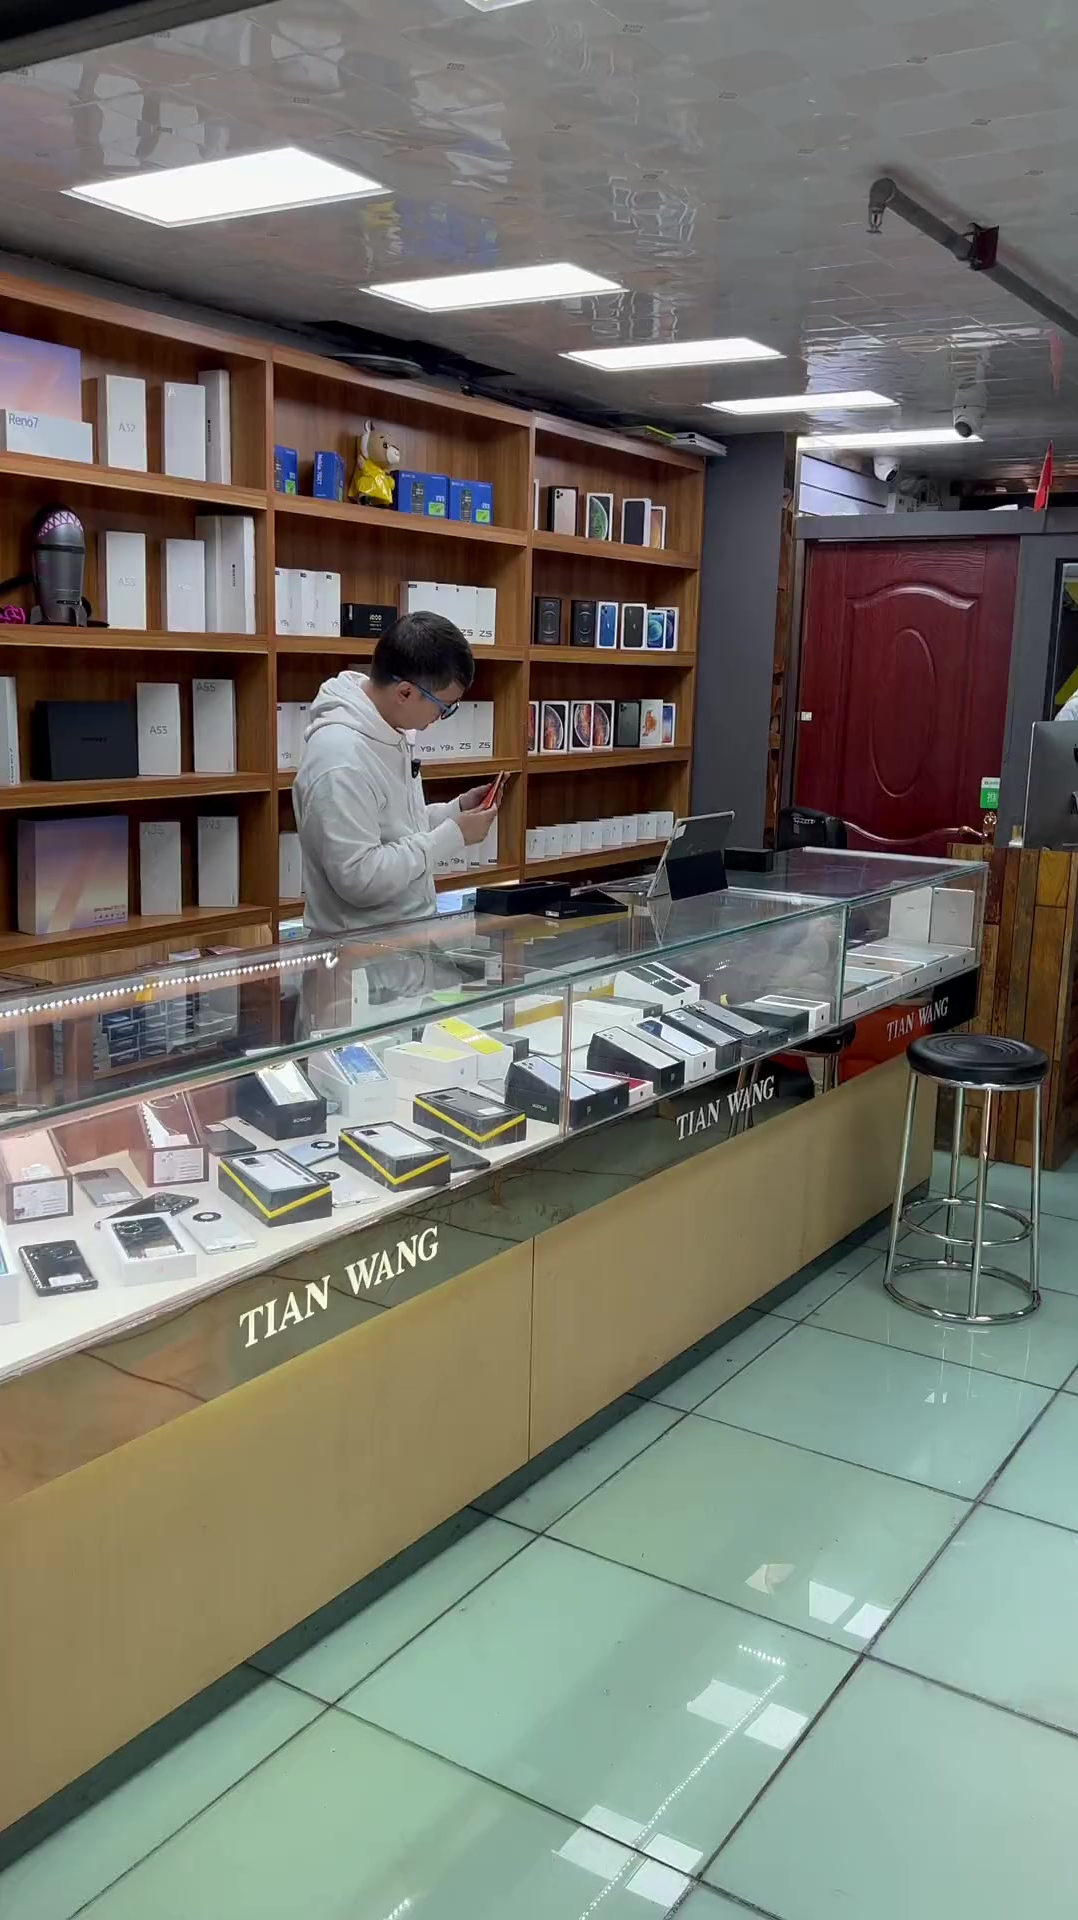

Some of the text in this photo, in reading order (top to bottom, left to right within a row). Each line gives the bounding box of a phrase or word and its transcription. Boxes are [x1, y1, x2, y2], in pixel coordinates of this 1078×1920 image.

[8, 412, 39, 429] Reno7
[478, 630, 493, 638] Z5
[149, 725, 168, 735] A53
[459, 742, 471, 750] Z5
[478, 741, 491, 749] Z5
[886, 996, 949, 1042] TIAN WANG
[676, 1075, 775, 1141] TIAN WANG
[239, 1225, 439, 1348] TIAN WANG
